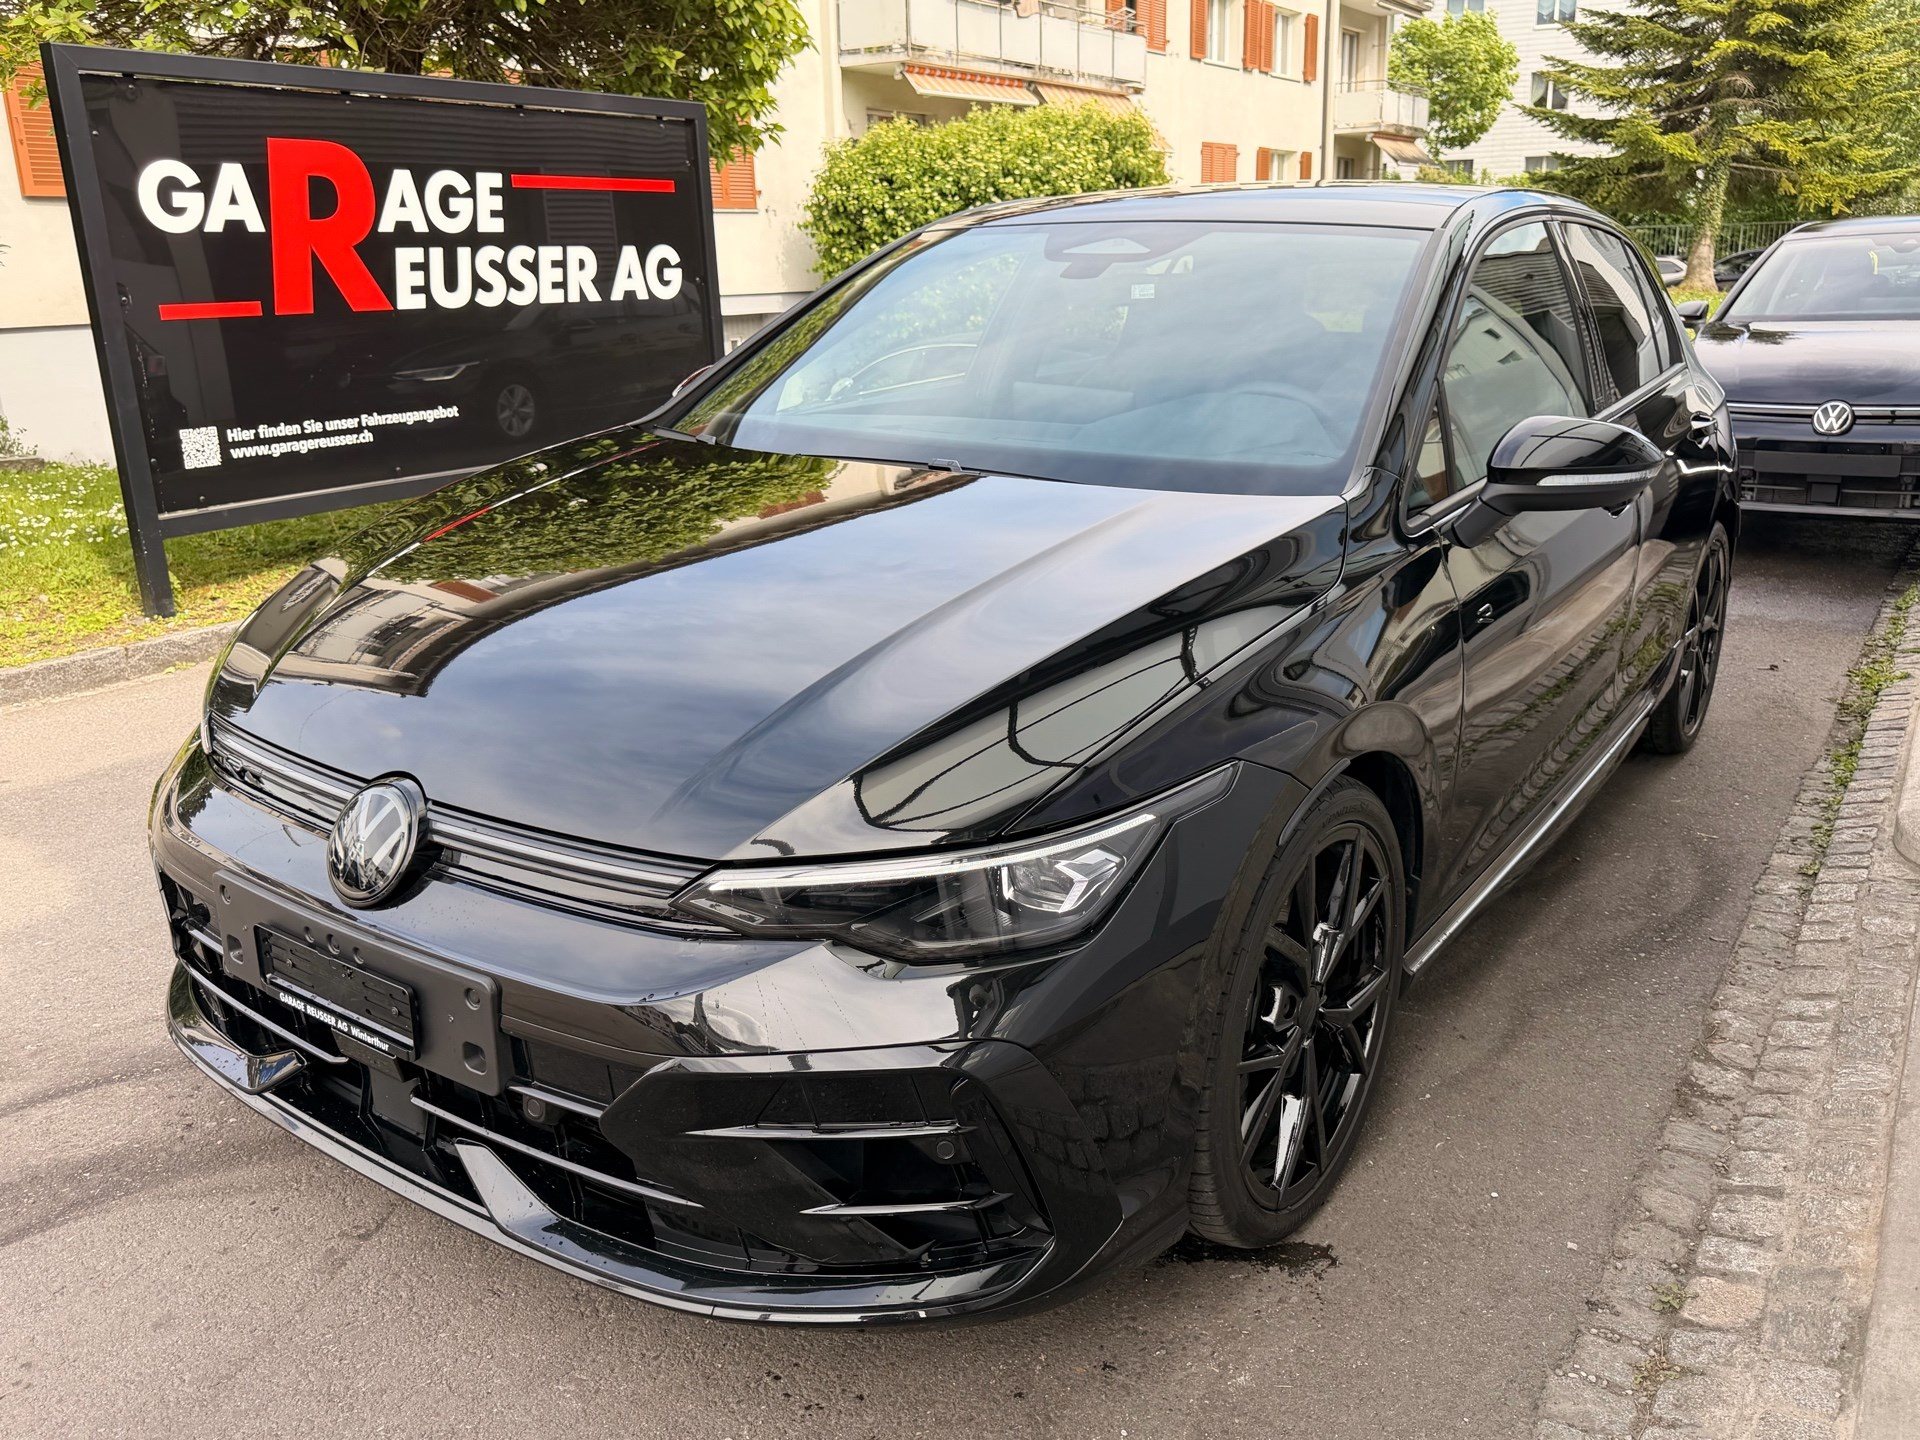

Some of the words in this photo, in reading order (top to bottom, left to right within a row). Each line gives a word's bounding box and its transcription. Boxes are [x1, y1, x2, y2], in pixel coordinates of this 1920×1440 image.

[610, 244, 683, 301] AG
[226, 427, 256, 443] Hier
[258, 422, 301, 439] finden
[303, 420, 324, 434] Sie
[325, 416, 359, 432] unser
[361, 405, 460, 428] Fahrzeugangebot
[230, 430, 373, 459] www.garagereusser.ch
[279, 992, 305, 1012] GARAGE
[306, 1004, 336, 1026] REUSSER
[337, 1019, 348, 1032] AG
[350, 1026, 389, 1052] Winterthur
